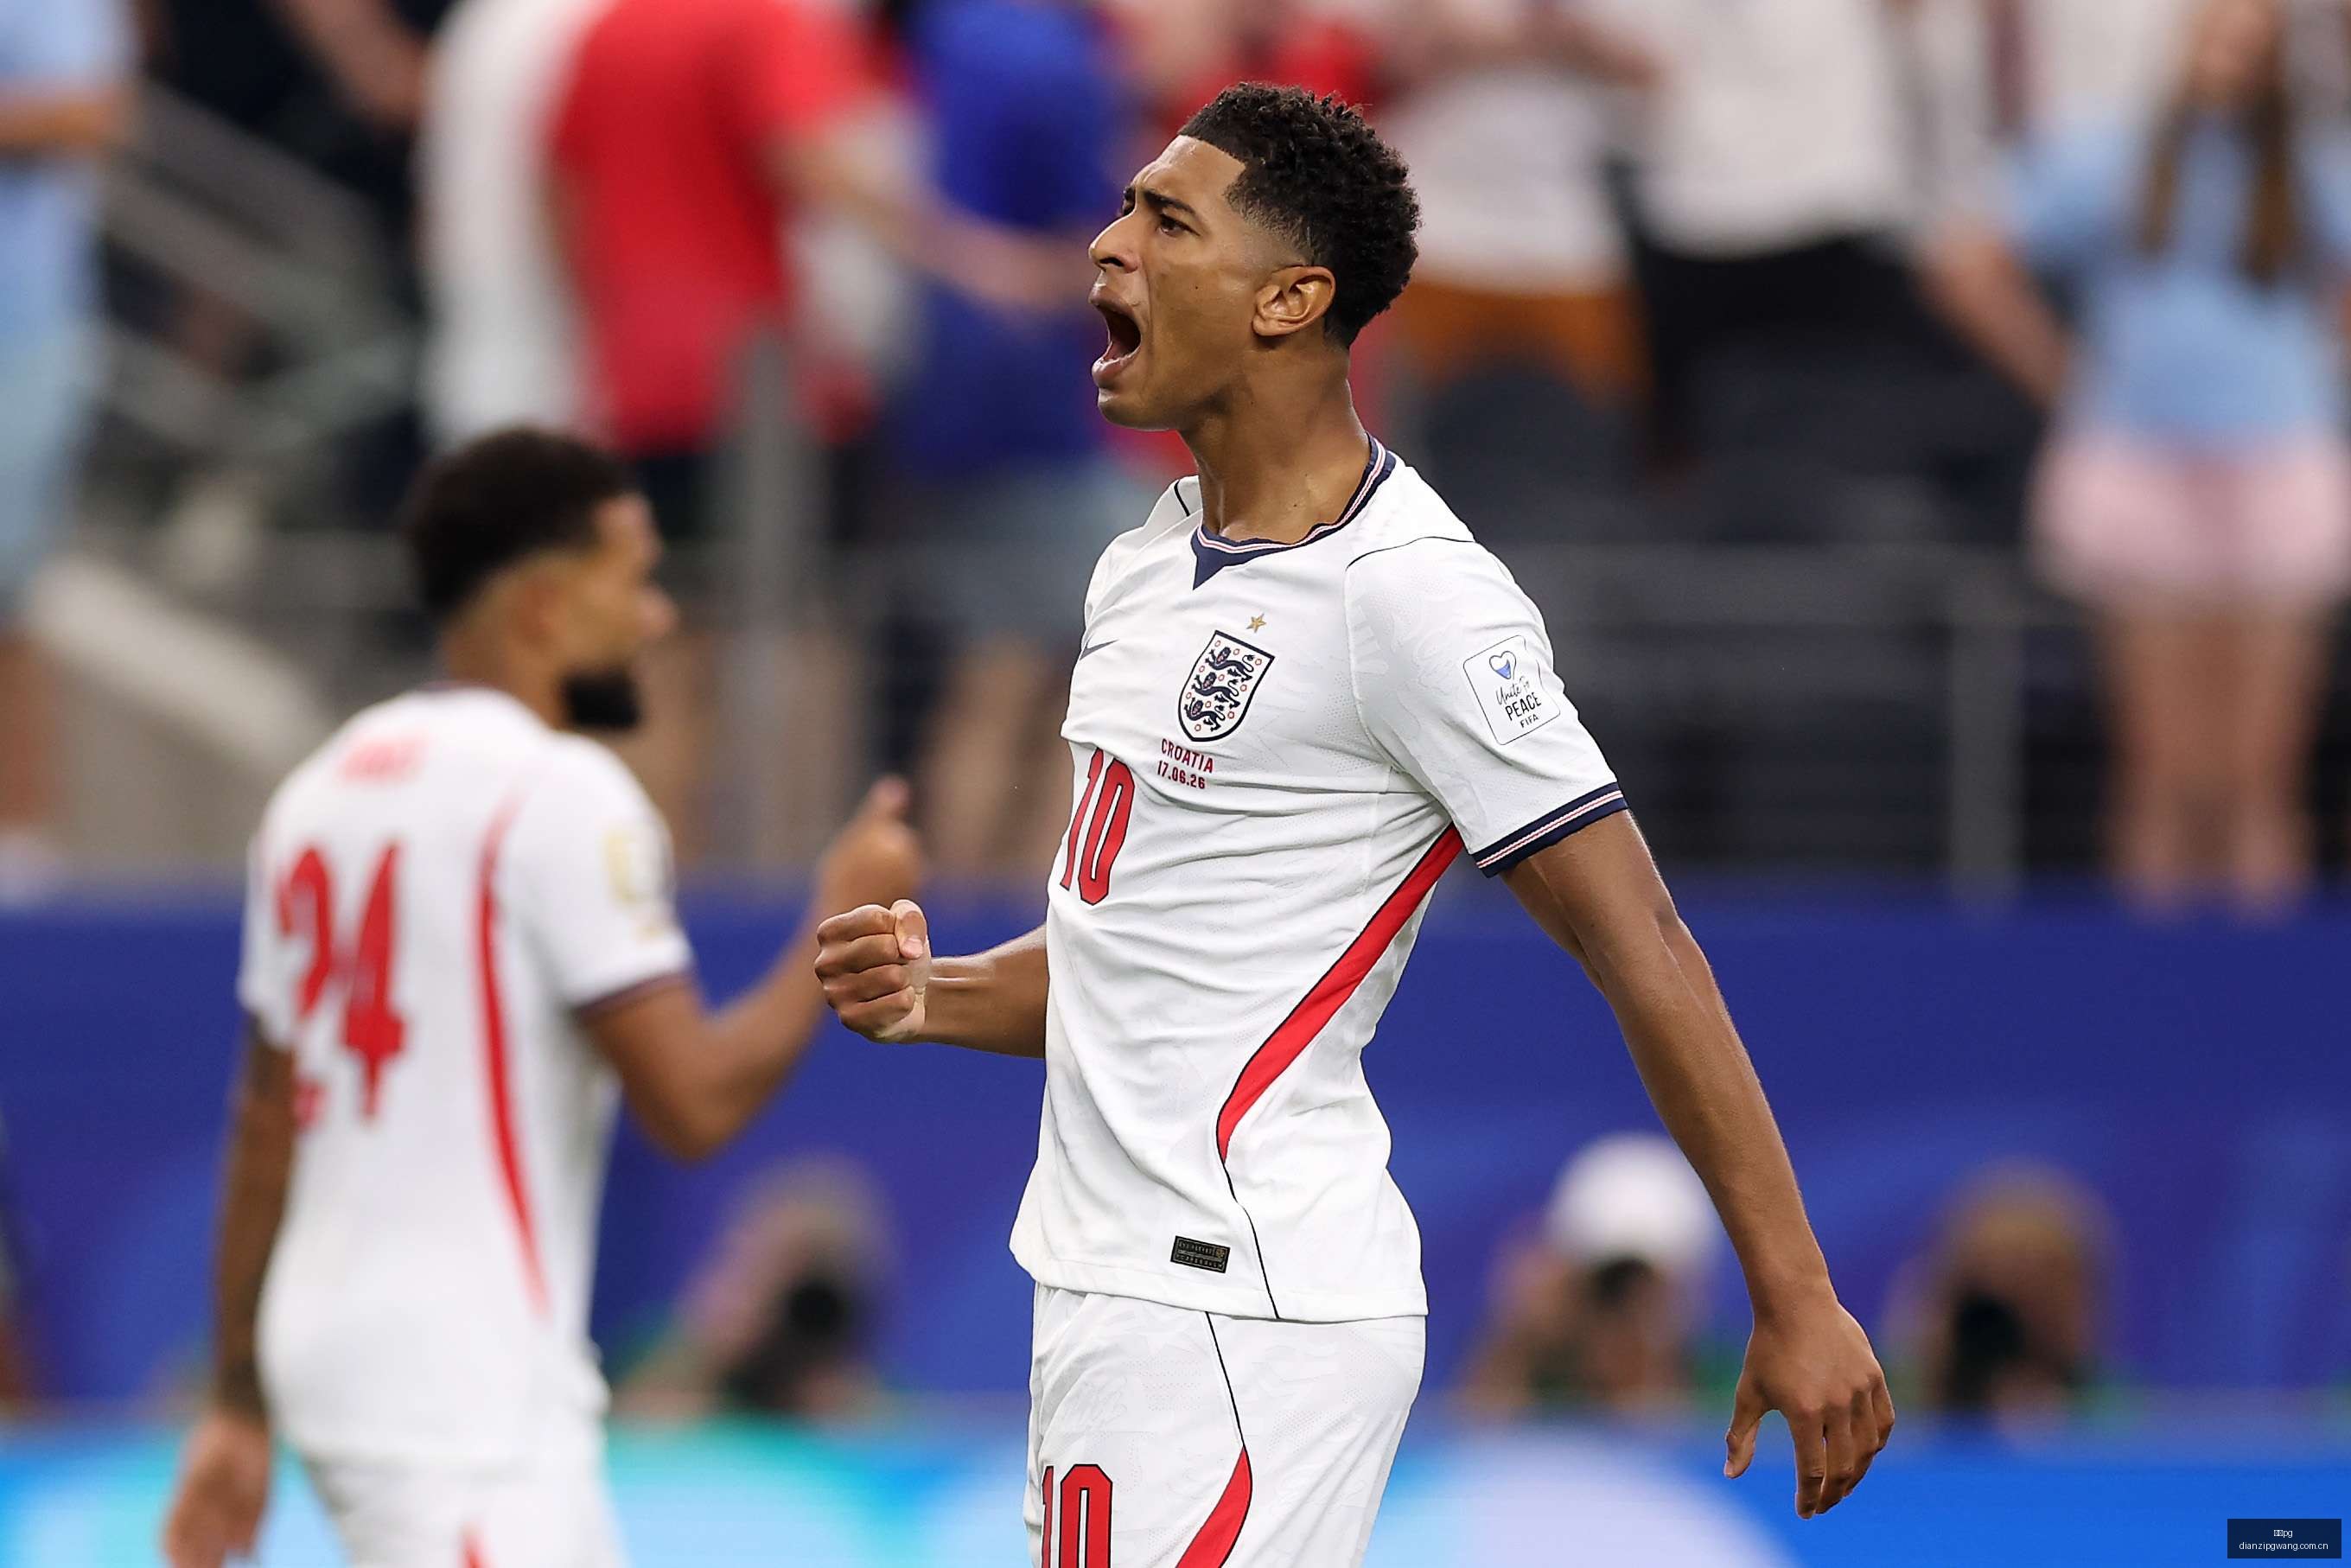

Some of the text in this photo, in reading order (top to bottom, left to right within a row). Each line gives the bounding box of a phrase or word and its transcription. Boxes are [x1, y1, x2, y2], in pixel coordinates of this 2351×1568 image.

[1495, 683, 1521, 705] Unite
[1505, 692, 1542, 722] PEACE
[1520, 713, 1539, 729] FIFA
[1161, 737, 1214, 774] CROATIA
[1156, 760, 1205, 790] 17.06.26
[1060, 746, 1135, 907] 10
[274, 837, 409, 1131] 24
[1042, 1463, 1113, 1568] 10
